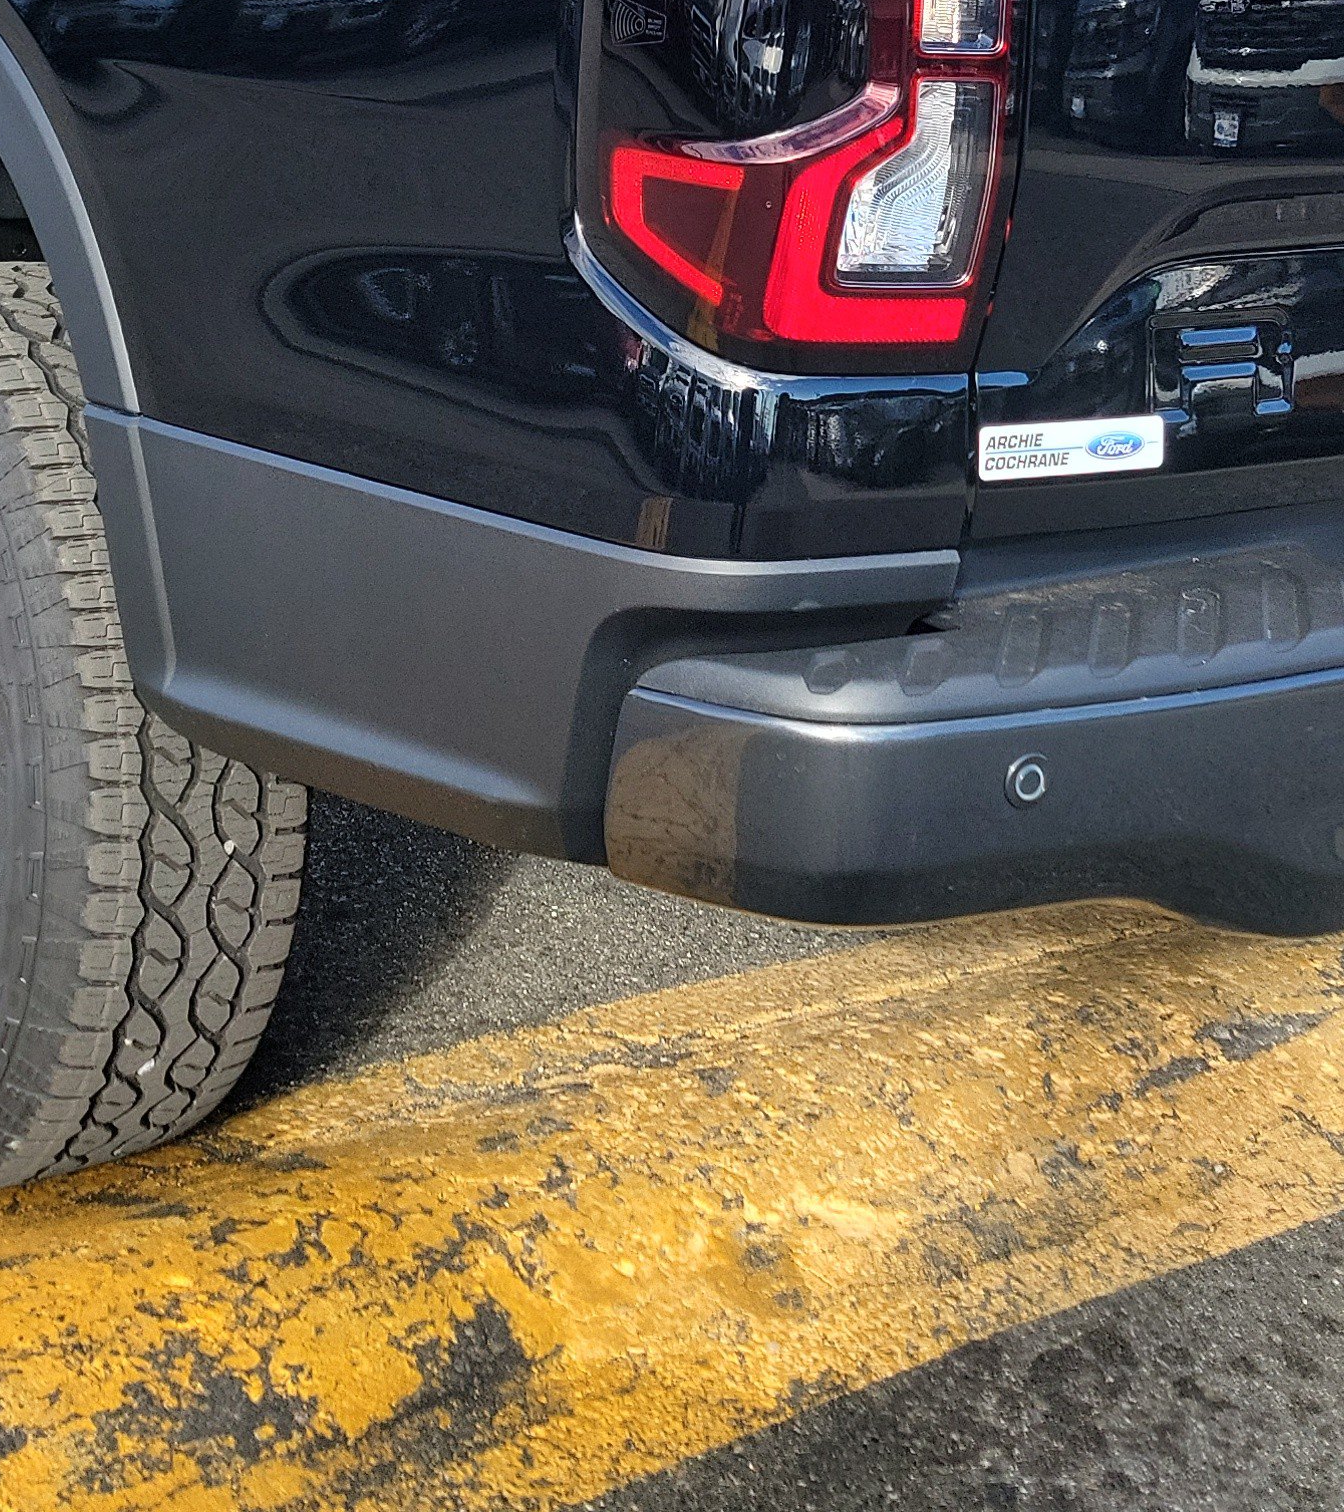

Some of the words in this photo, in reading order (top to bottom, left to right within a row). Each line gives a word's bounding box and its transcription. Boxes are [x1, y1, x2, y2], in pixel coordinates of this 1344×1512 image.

[985, 433, 1044, 451] ARCHIE
[1097, 437, 1134, 455] Ford
[984, 452, 1070, 472] COCHRANE
